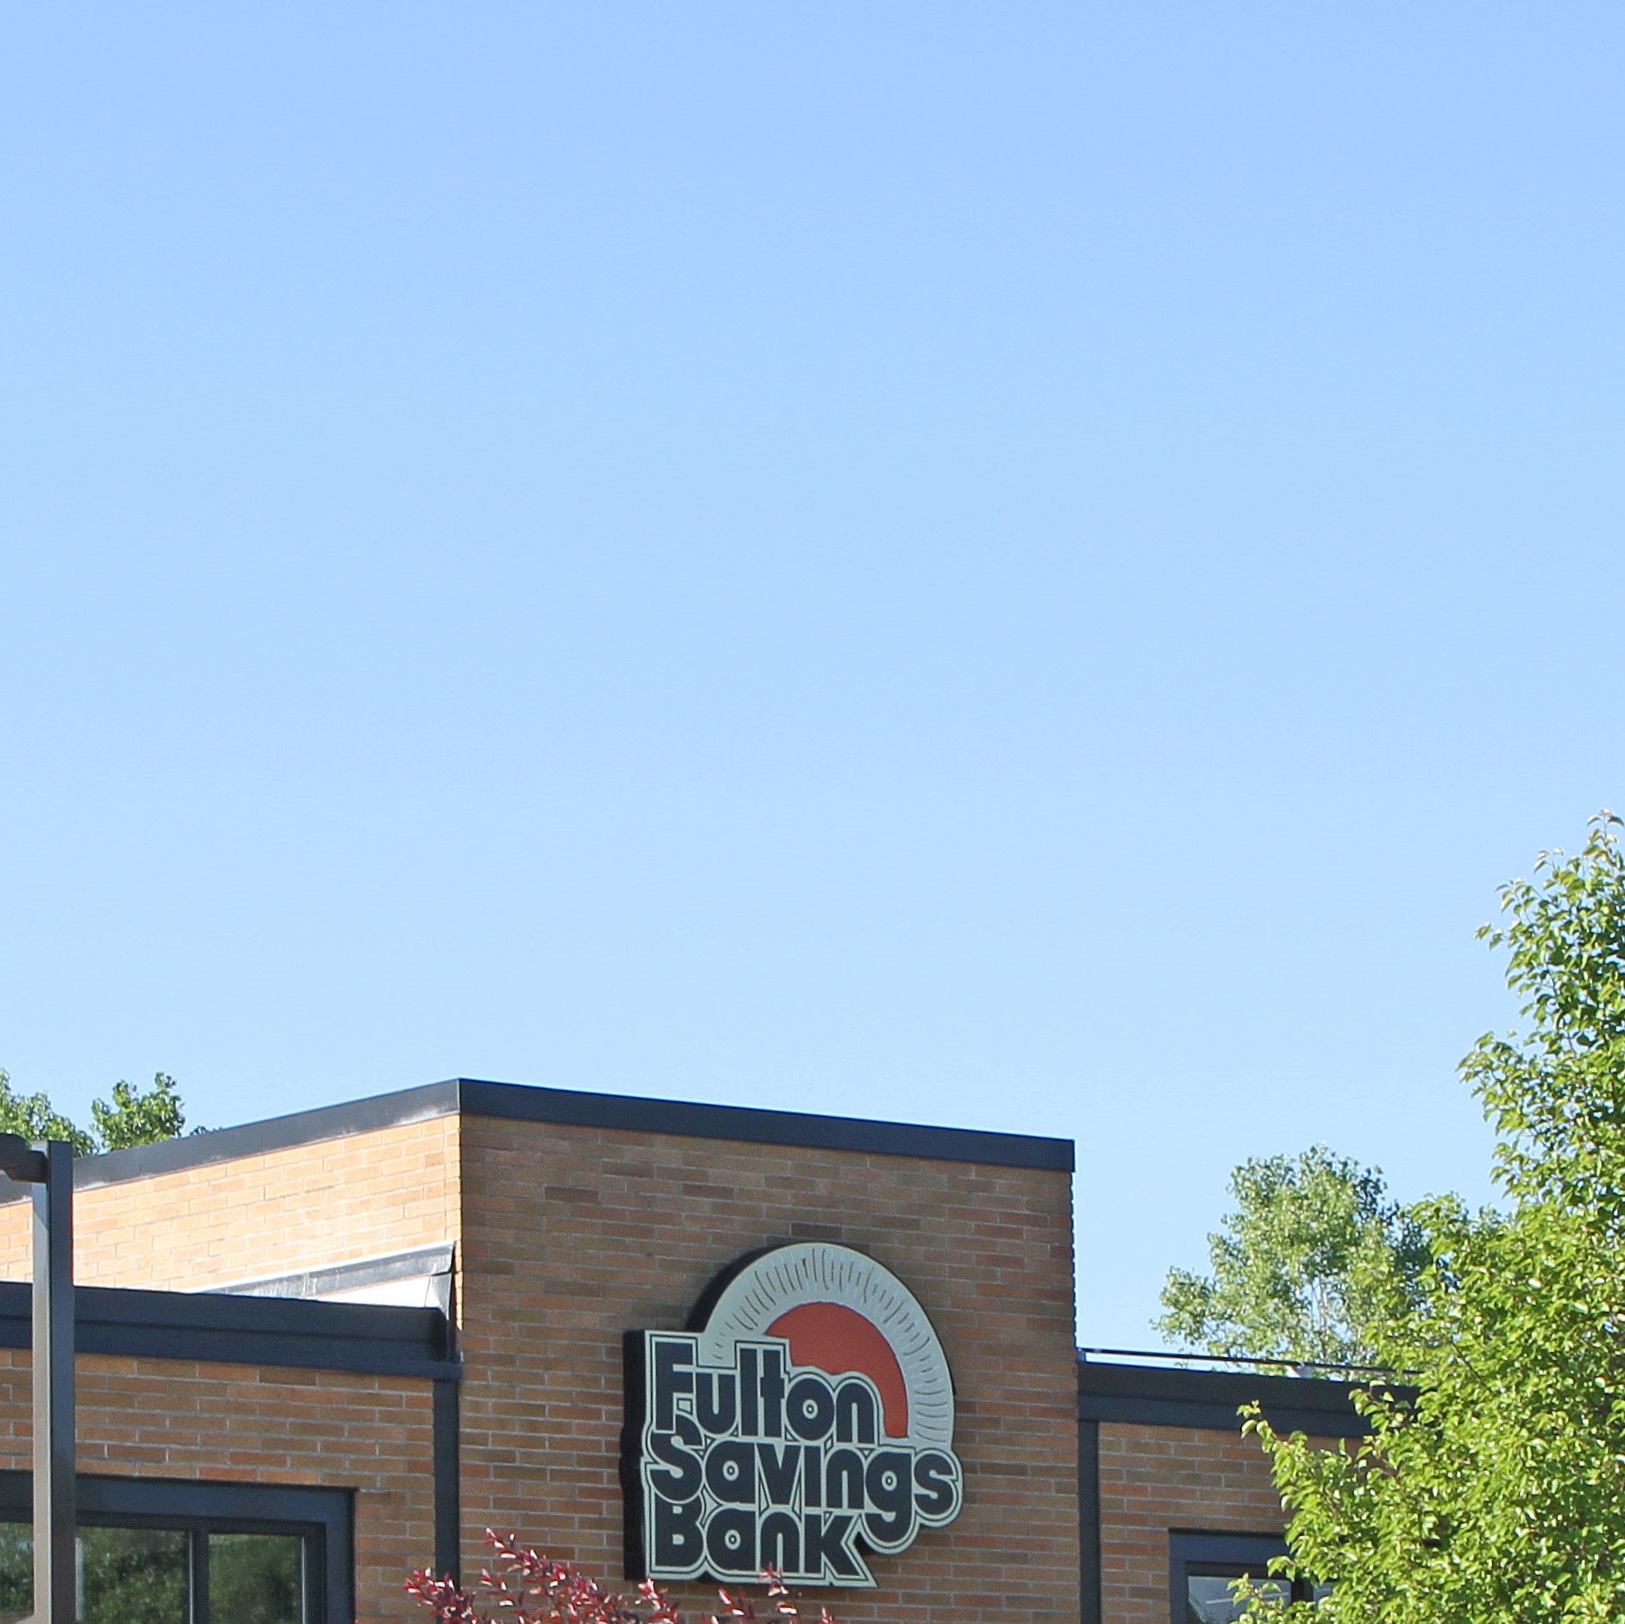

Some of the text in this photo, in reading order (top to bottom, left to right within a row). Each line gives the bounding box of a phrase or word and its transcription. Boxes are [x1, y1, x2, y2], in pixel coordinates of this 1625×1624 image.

[654, 1340, 877, 1443] Fulton
[650, 1414, 959, 1543] Savings
[654, 1500, 863, 1575] Bank
